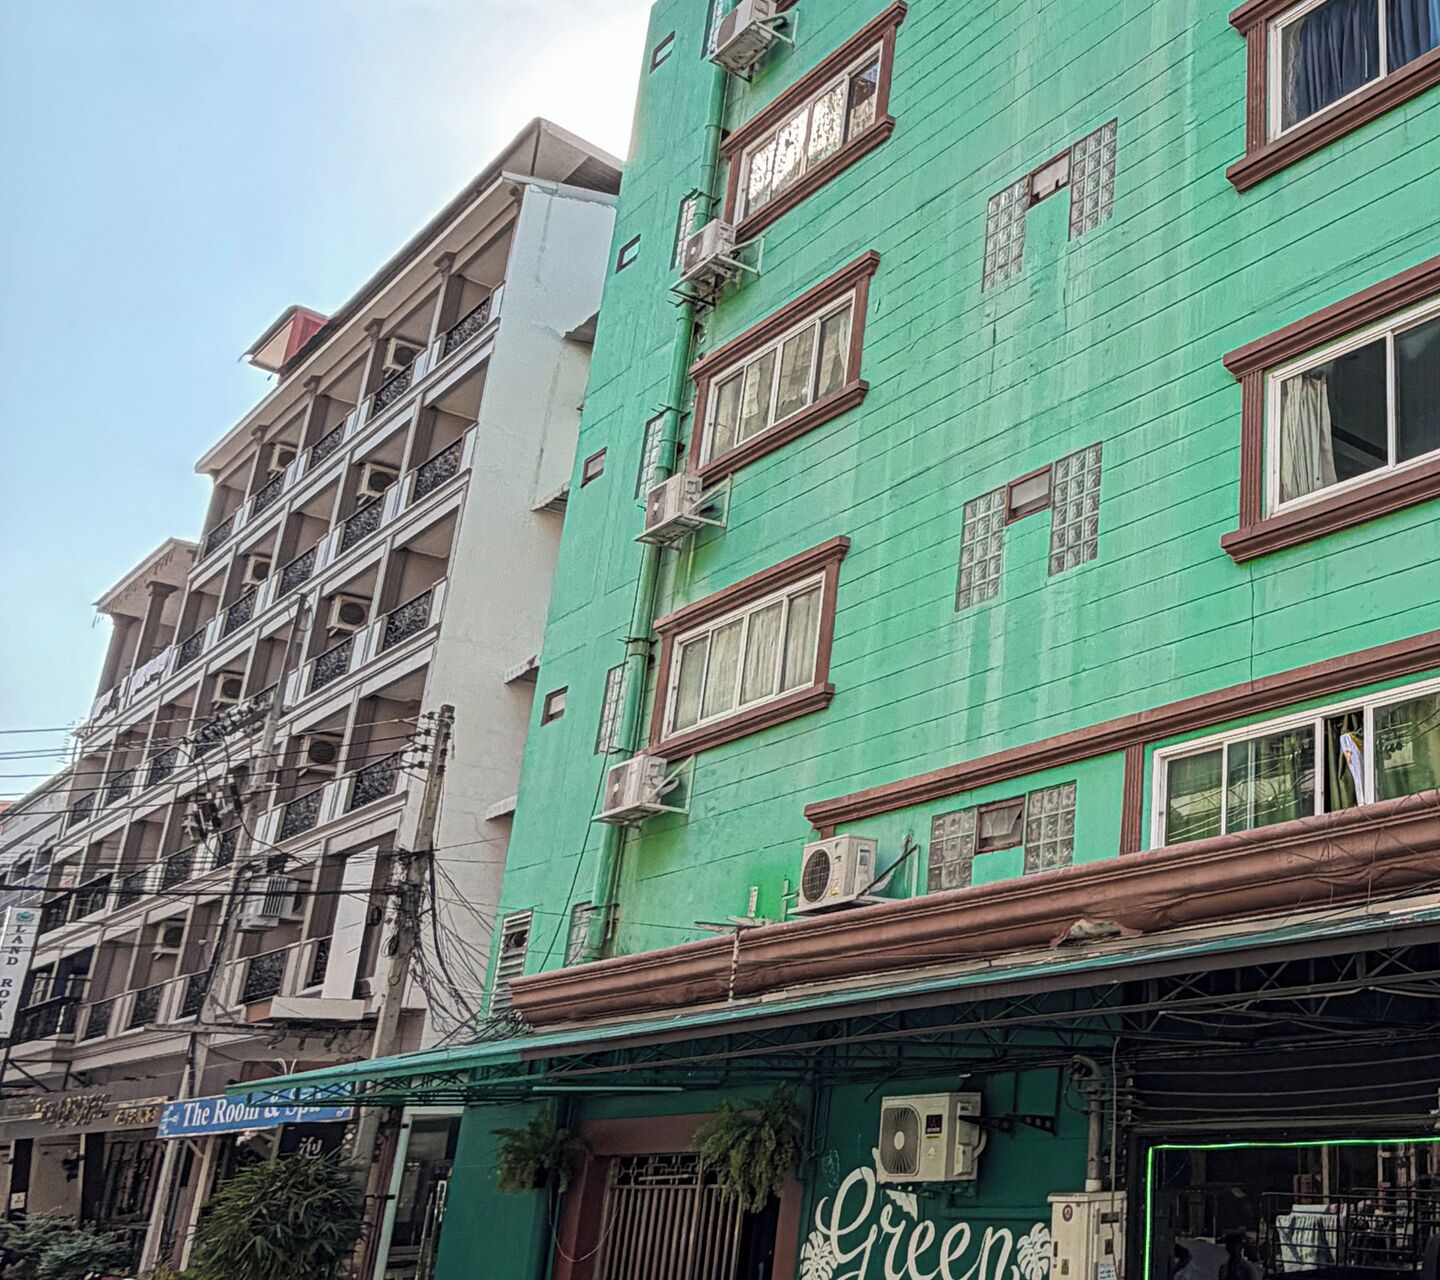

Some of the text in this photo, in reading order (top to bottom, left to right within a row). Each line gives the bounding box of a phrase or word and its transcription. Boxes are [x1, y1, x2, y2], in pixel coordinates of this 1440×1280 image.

[6, 924, 26, 966] LAND
[183, 1102, 211, 1128] The
[211, 1097, 260, 1126] Room
